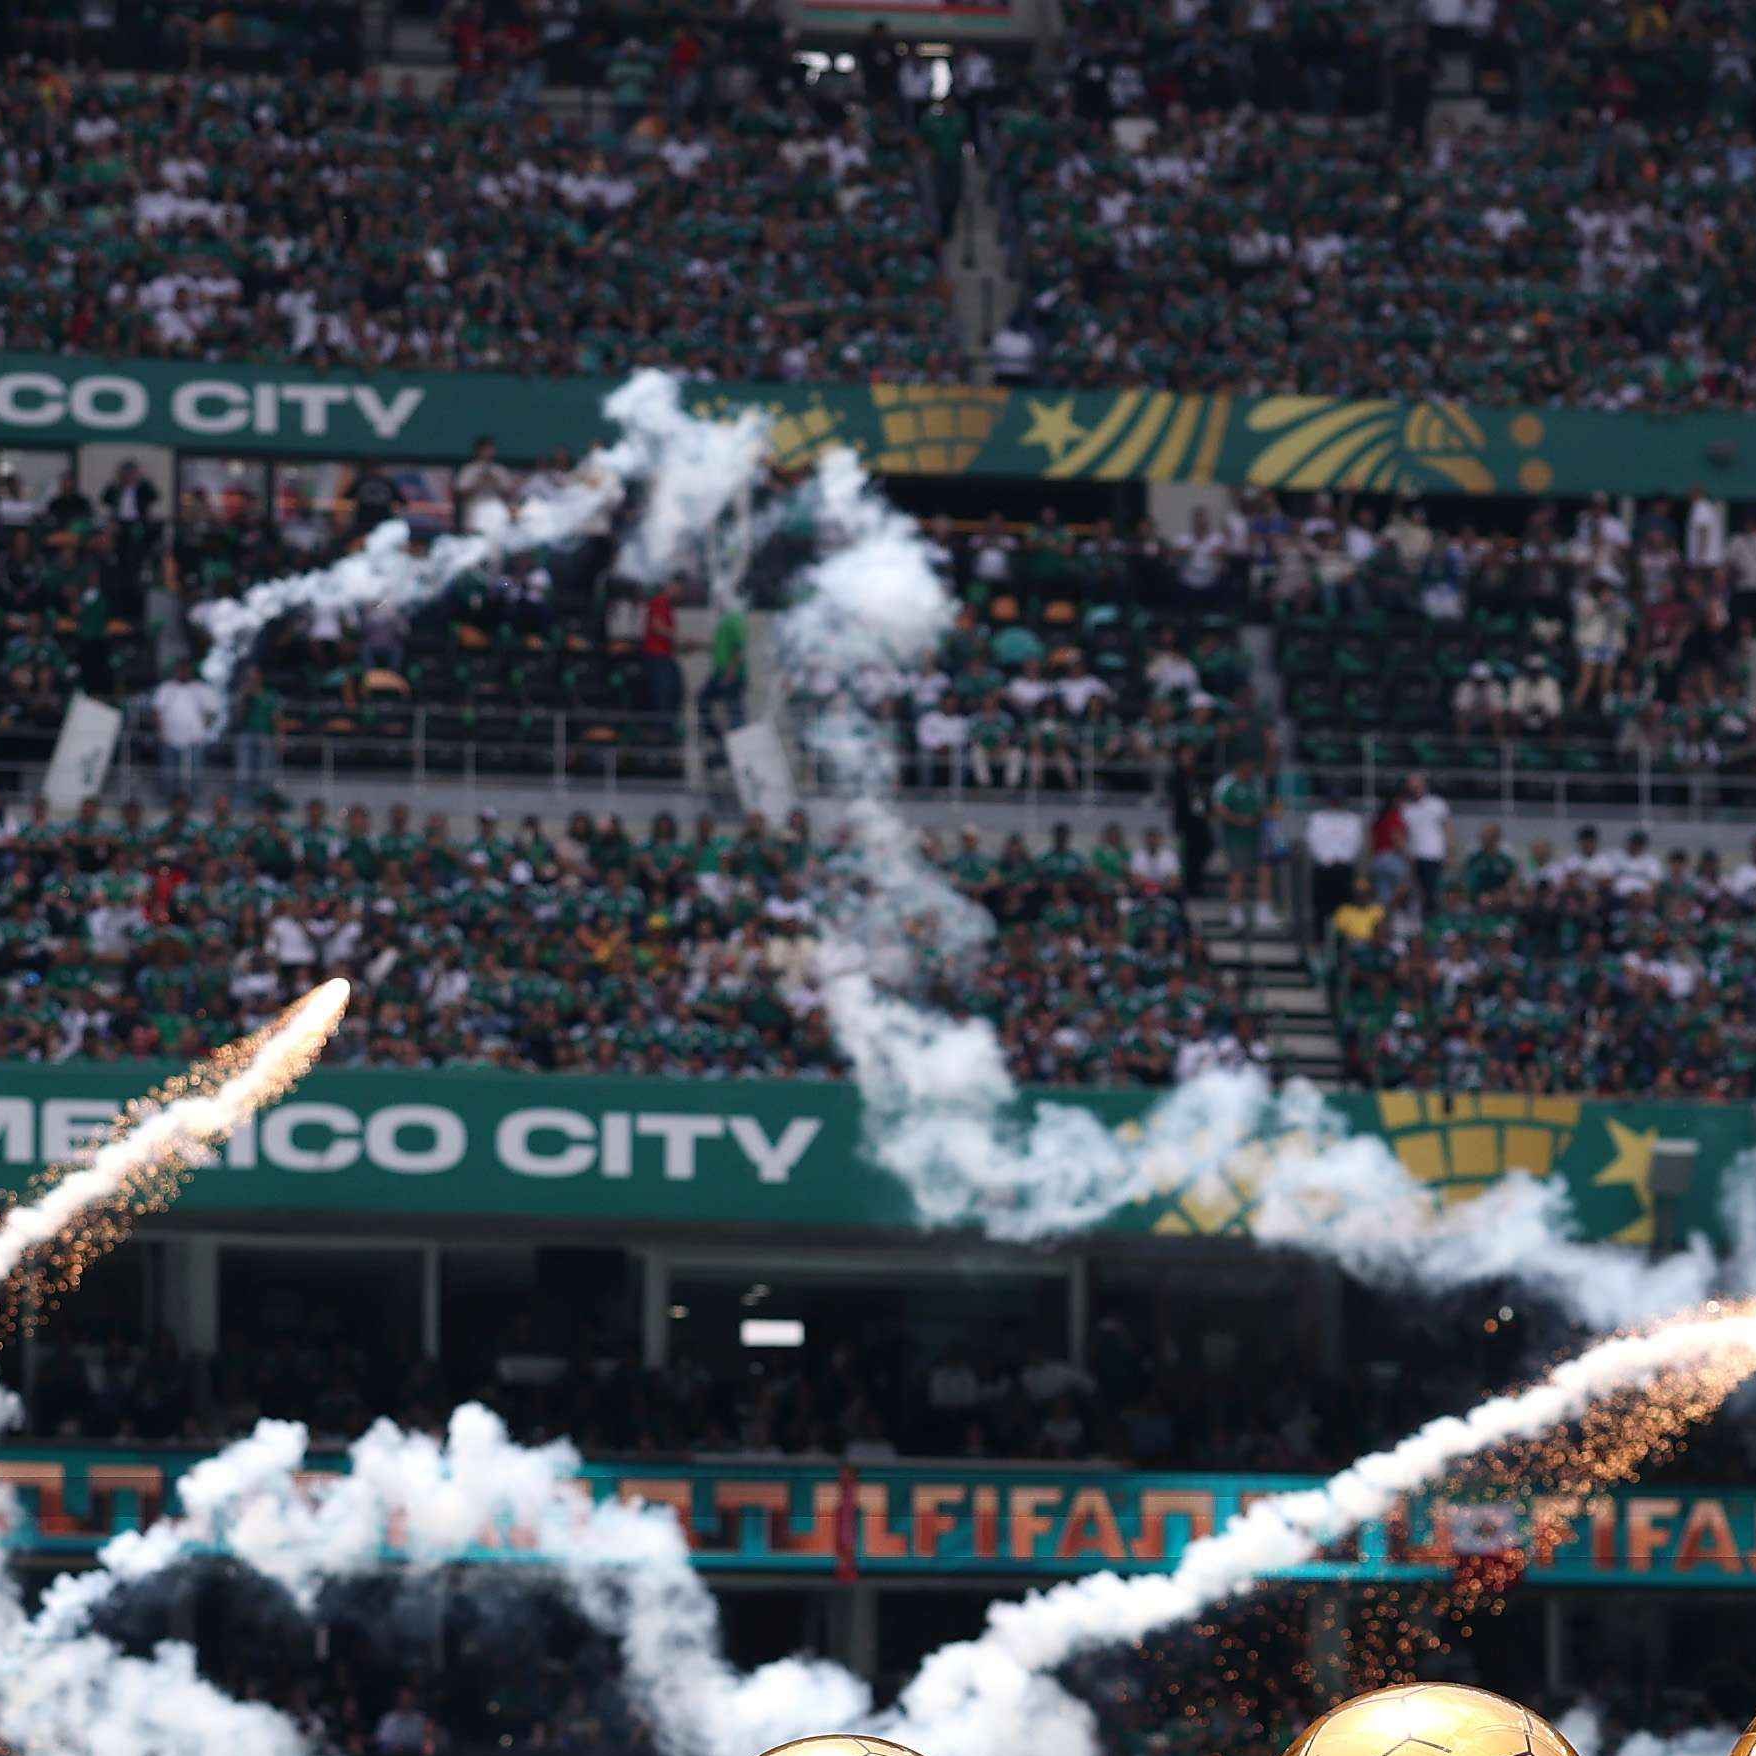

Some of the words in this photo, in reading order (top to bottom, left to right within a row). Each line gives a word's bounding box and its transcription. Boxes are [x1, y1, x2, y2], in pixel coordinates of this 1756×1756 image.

[171, 381, 426, 438] CITY
[496, 1105, 822, 1183] CITY
[913, 1484, 1126, 1559] FIFA
[1532, 1497, 1744, 1574] FIFA
